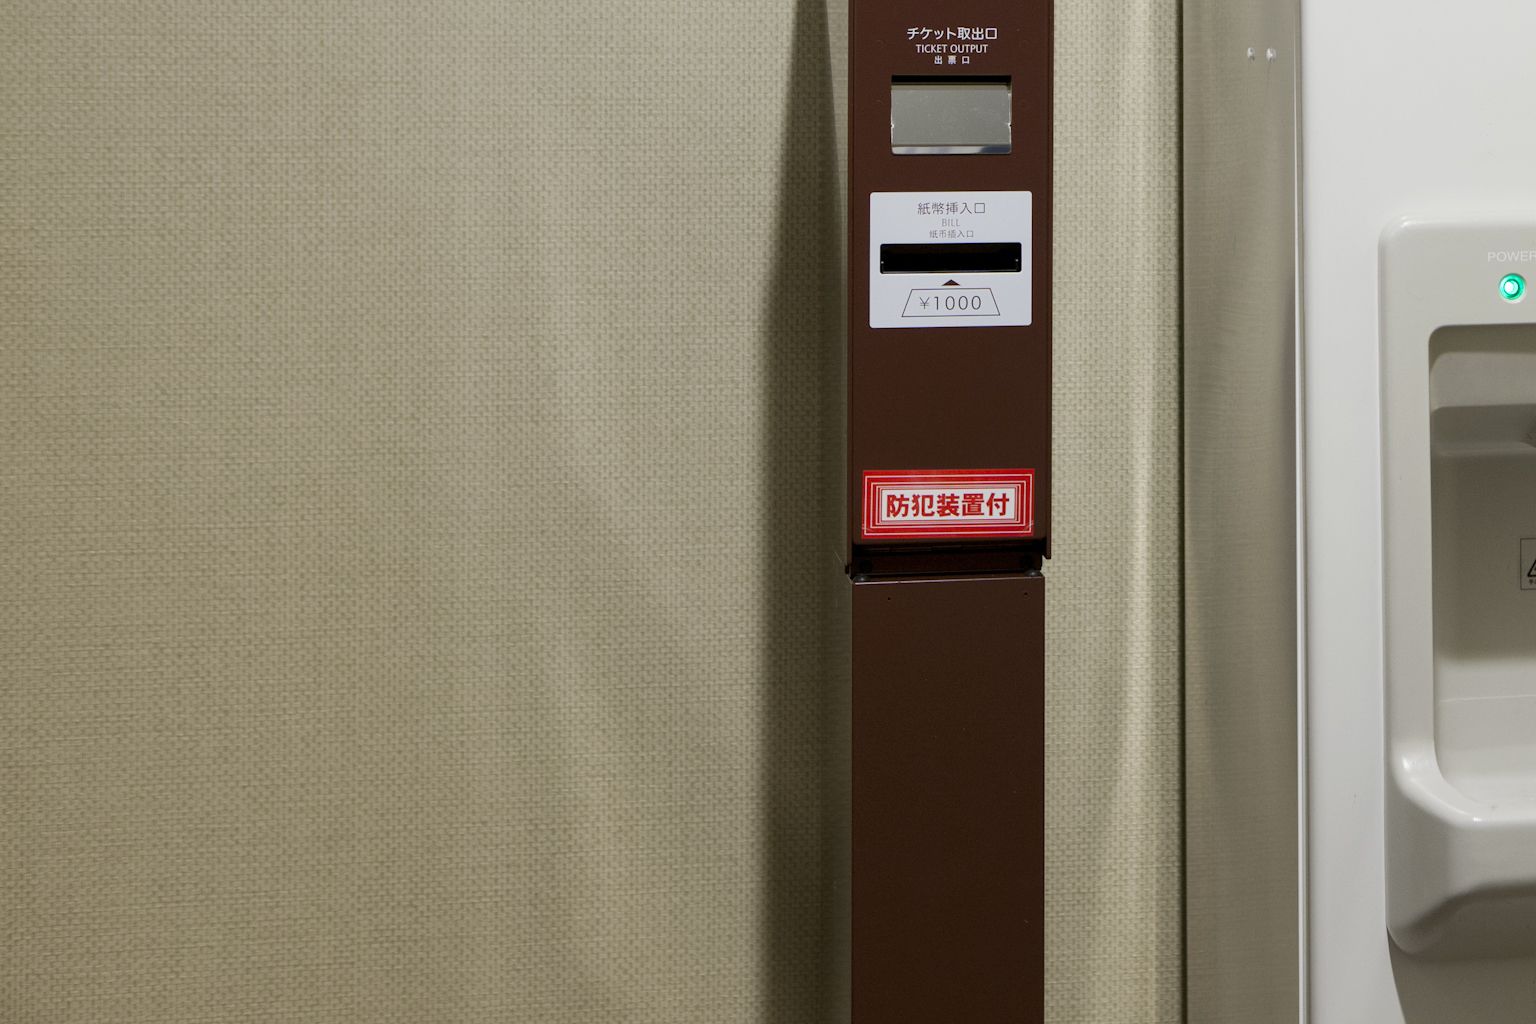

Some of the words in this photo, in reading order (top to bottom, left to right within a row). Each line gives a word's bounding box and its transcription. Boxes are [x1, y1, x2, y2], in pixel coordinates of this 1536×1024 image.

[906, 27, 998, 41] チケット取出口
[915, 44, 948, 54] TICKET
[950, 44, 989, 54] OUTPUT
[917, 202, 986, 216] 紙幣挿入口
[941, 218, 960, 227] BILL
[919, 295, 982, 311] ¥1000
[886, 493, 1010, 518] 防犯装置付
